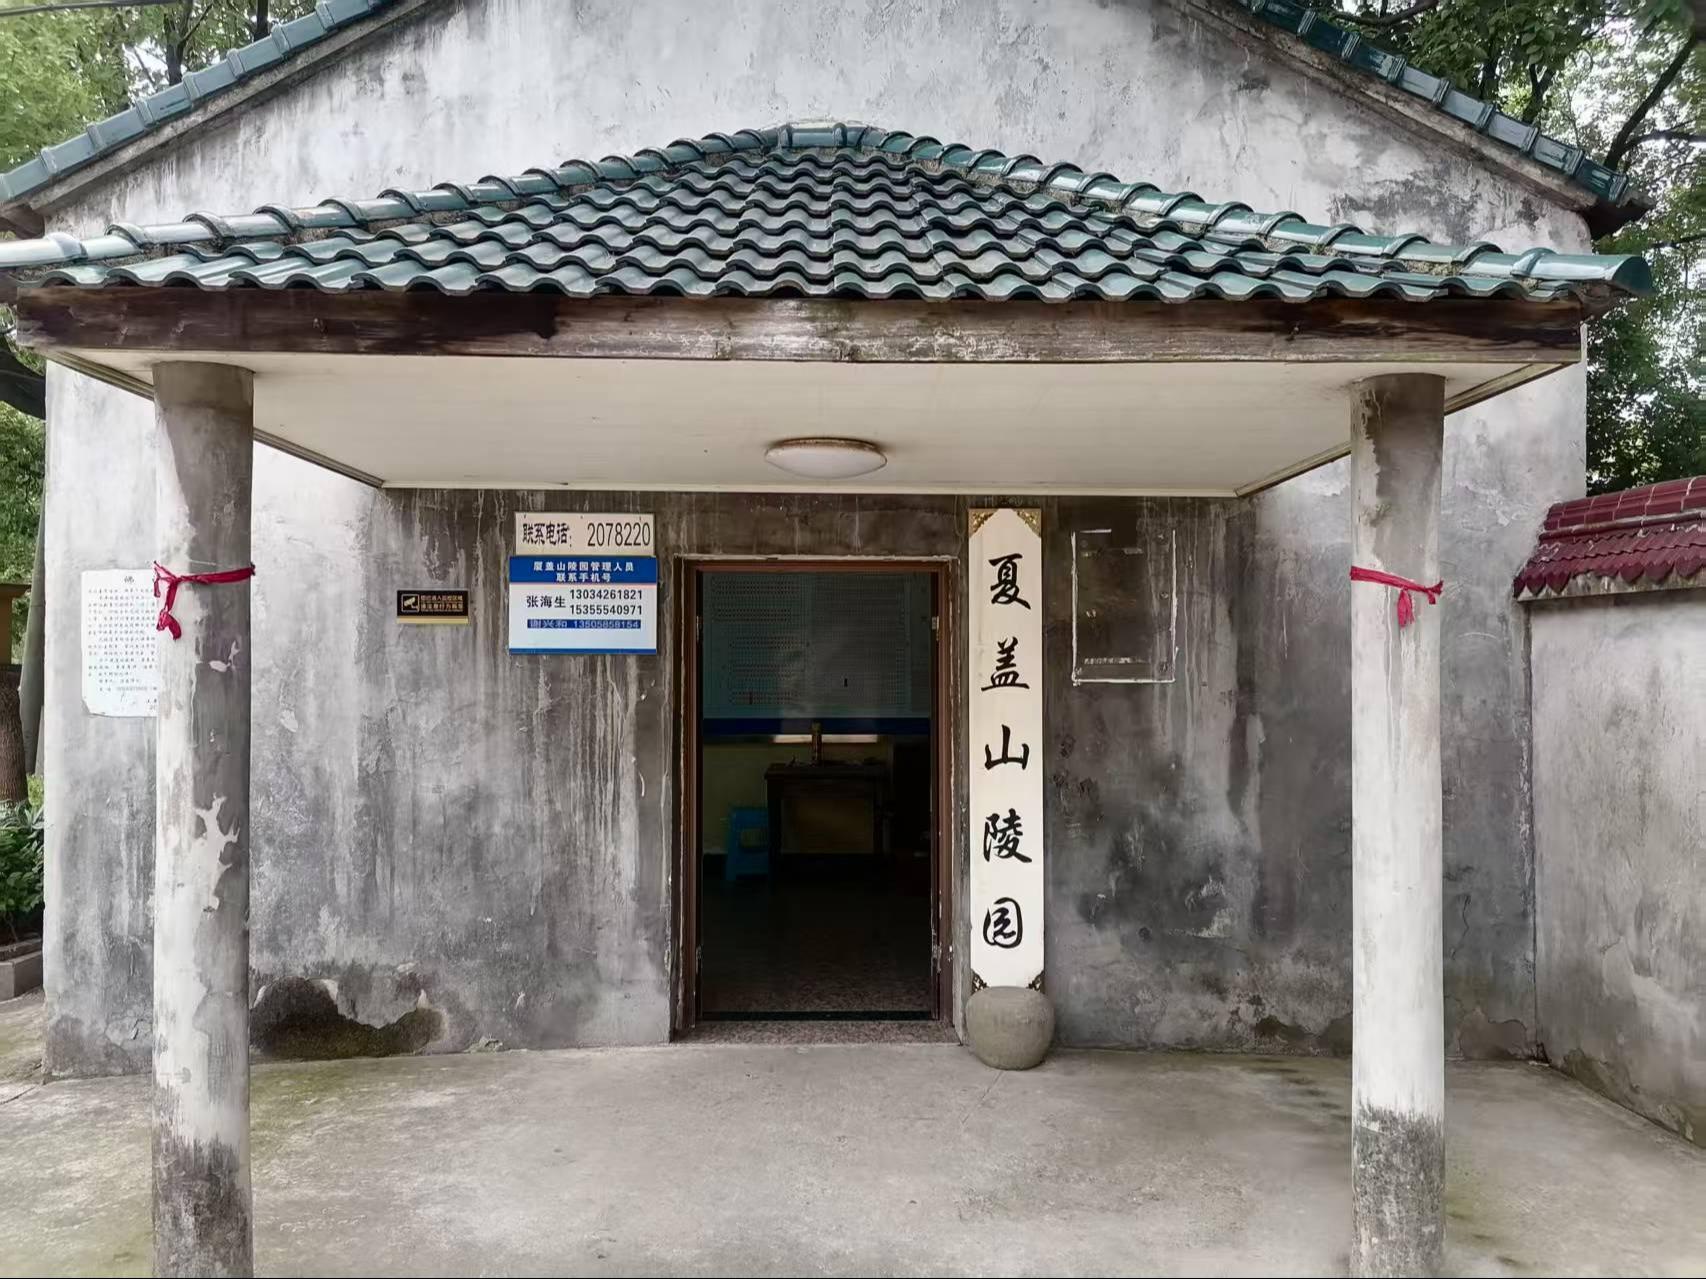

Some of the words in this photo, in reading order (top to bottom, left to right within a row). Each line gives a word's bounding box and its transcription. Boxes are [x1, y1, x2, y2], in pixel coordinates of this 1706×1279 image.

[587, 522, 651, 547] 2078220
[556, 573, 612, 583] 联系手机号
[526, 595, 566, 608] 张海生
[569, 589, 643, 600] 13034261821
[569, 604, 643, 615] 15355540971
[981, 552, 1032, 949] 夏盖山陵园
